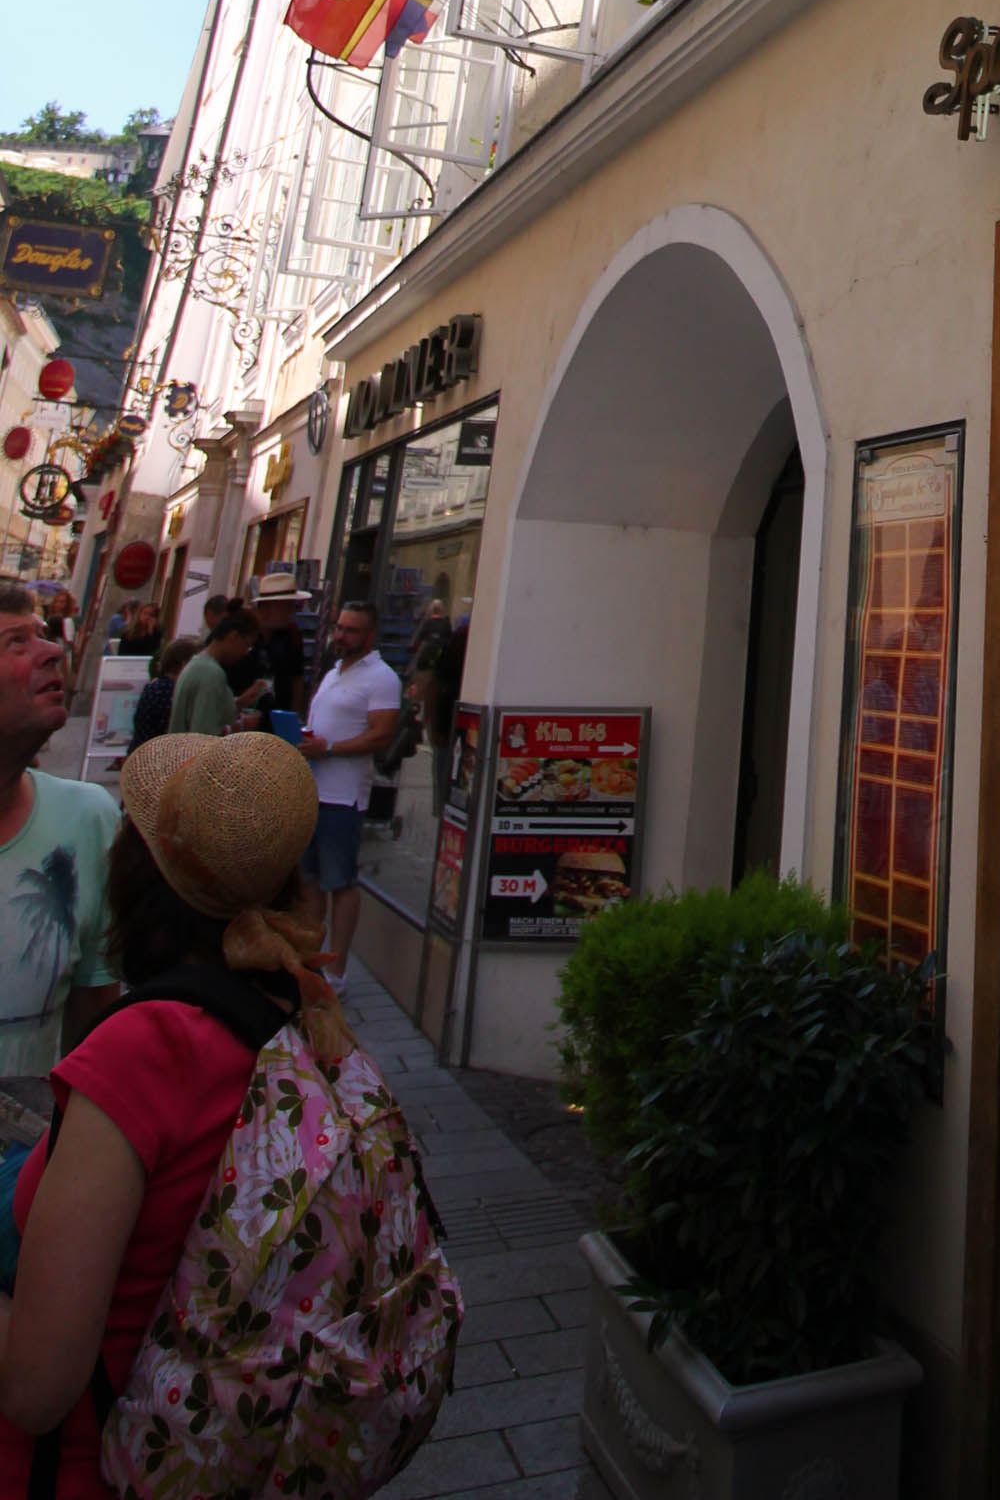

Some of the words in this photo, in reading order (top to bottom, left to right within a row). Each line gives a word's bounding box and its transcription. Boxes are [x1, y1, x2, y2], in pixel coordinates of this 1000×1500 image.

[579, 722, 607, 742] 168
[499, 879, 519, 893] 30
[523, 880, 537, 893] M
